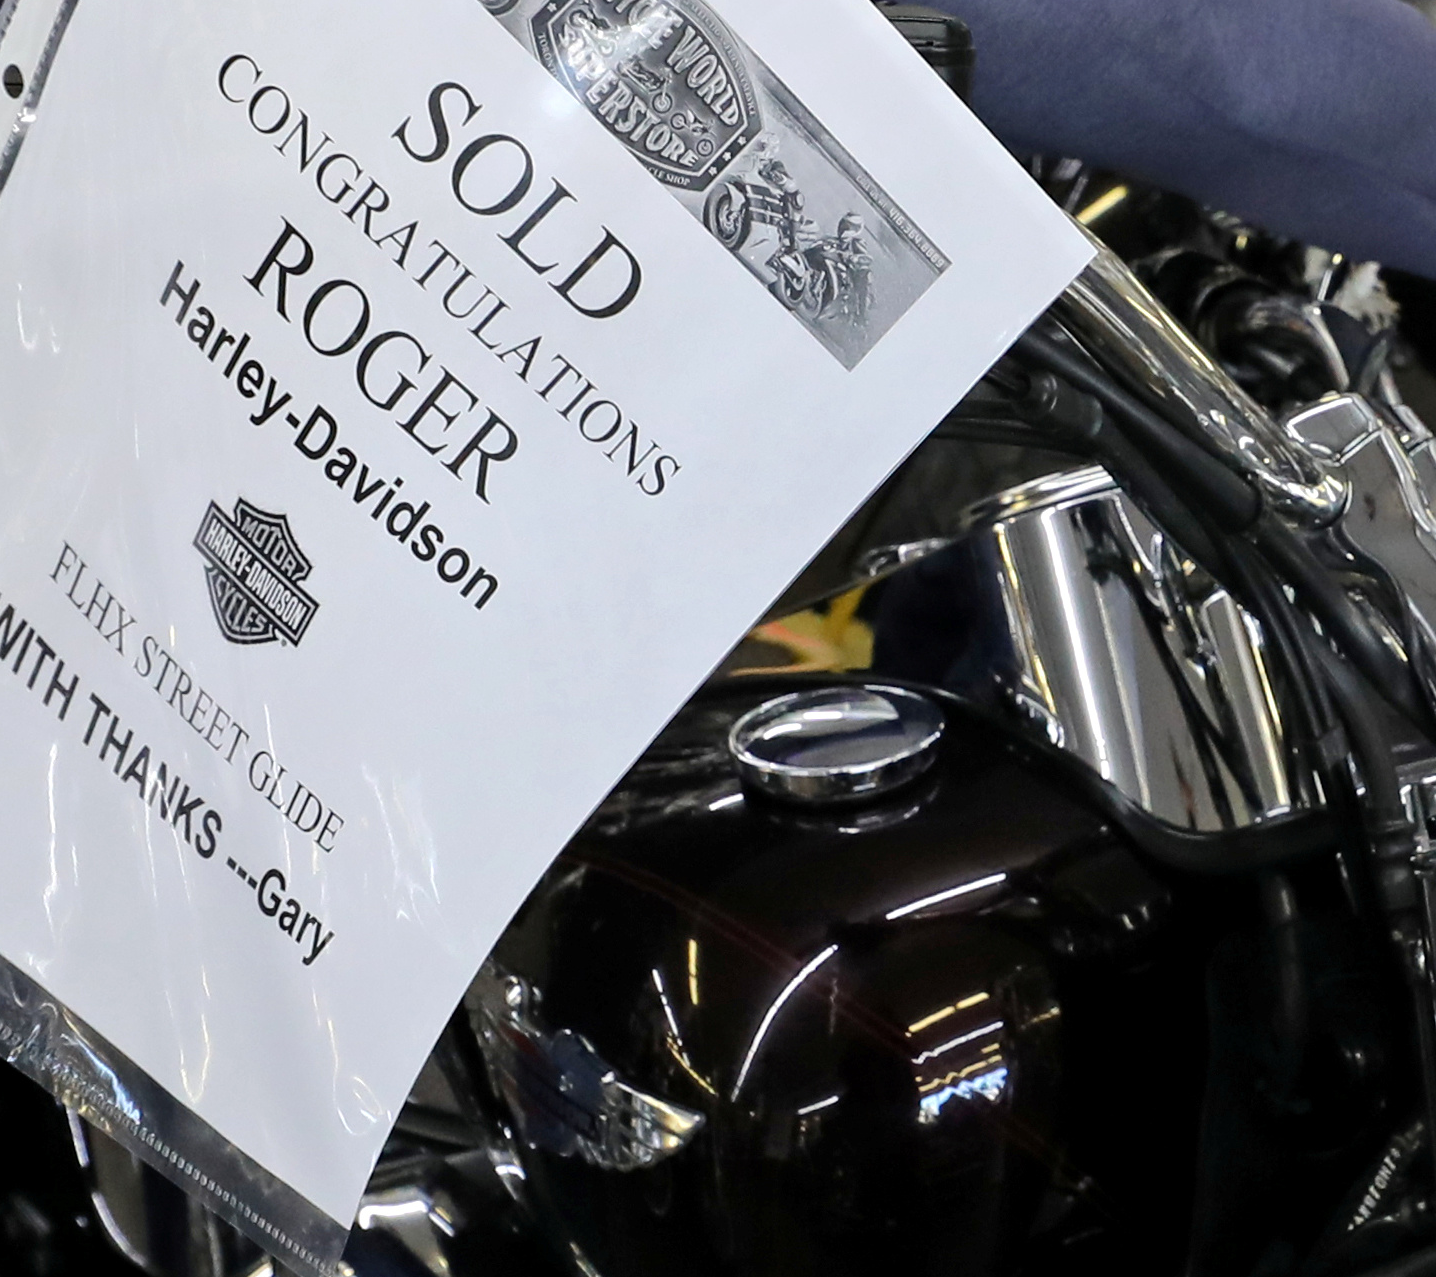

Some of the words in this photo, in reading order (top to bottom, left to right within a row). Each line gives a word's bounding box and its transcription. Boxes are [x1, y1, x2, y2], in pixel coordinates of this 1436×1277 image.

[559, 24, 699, 168] SUPERSTORE
[666, 26, 741, 126] WORLD
[391, 81, 643, 319] SOLD
[665, 172, 691, 186] SHOP
[218, 54, 683, 497] CONGRATULATIONS
[158, 260, 500, 612] Harley-Davidson
[243, 216, 520, 505] ROGER
[204, 518, 307, 631] HARLEY-DAVIDSON
[214, 574, 268, 633] CYCLES
[240, 516, 298, 577] MOTOR
[48, 540, 139, 656] FLHX
[134, 635, 249, 766] STREET
[248, 751, 345, 853] GLIDE
[80, 693, 223, 859] THANKS
